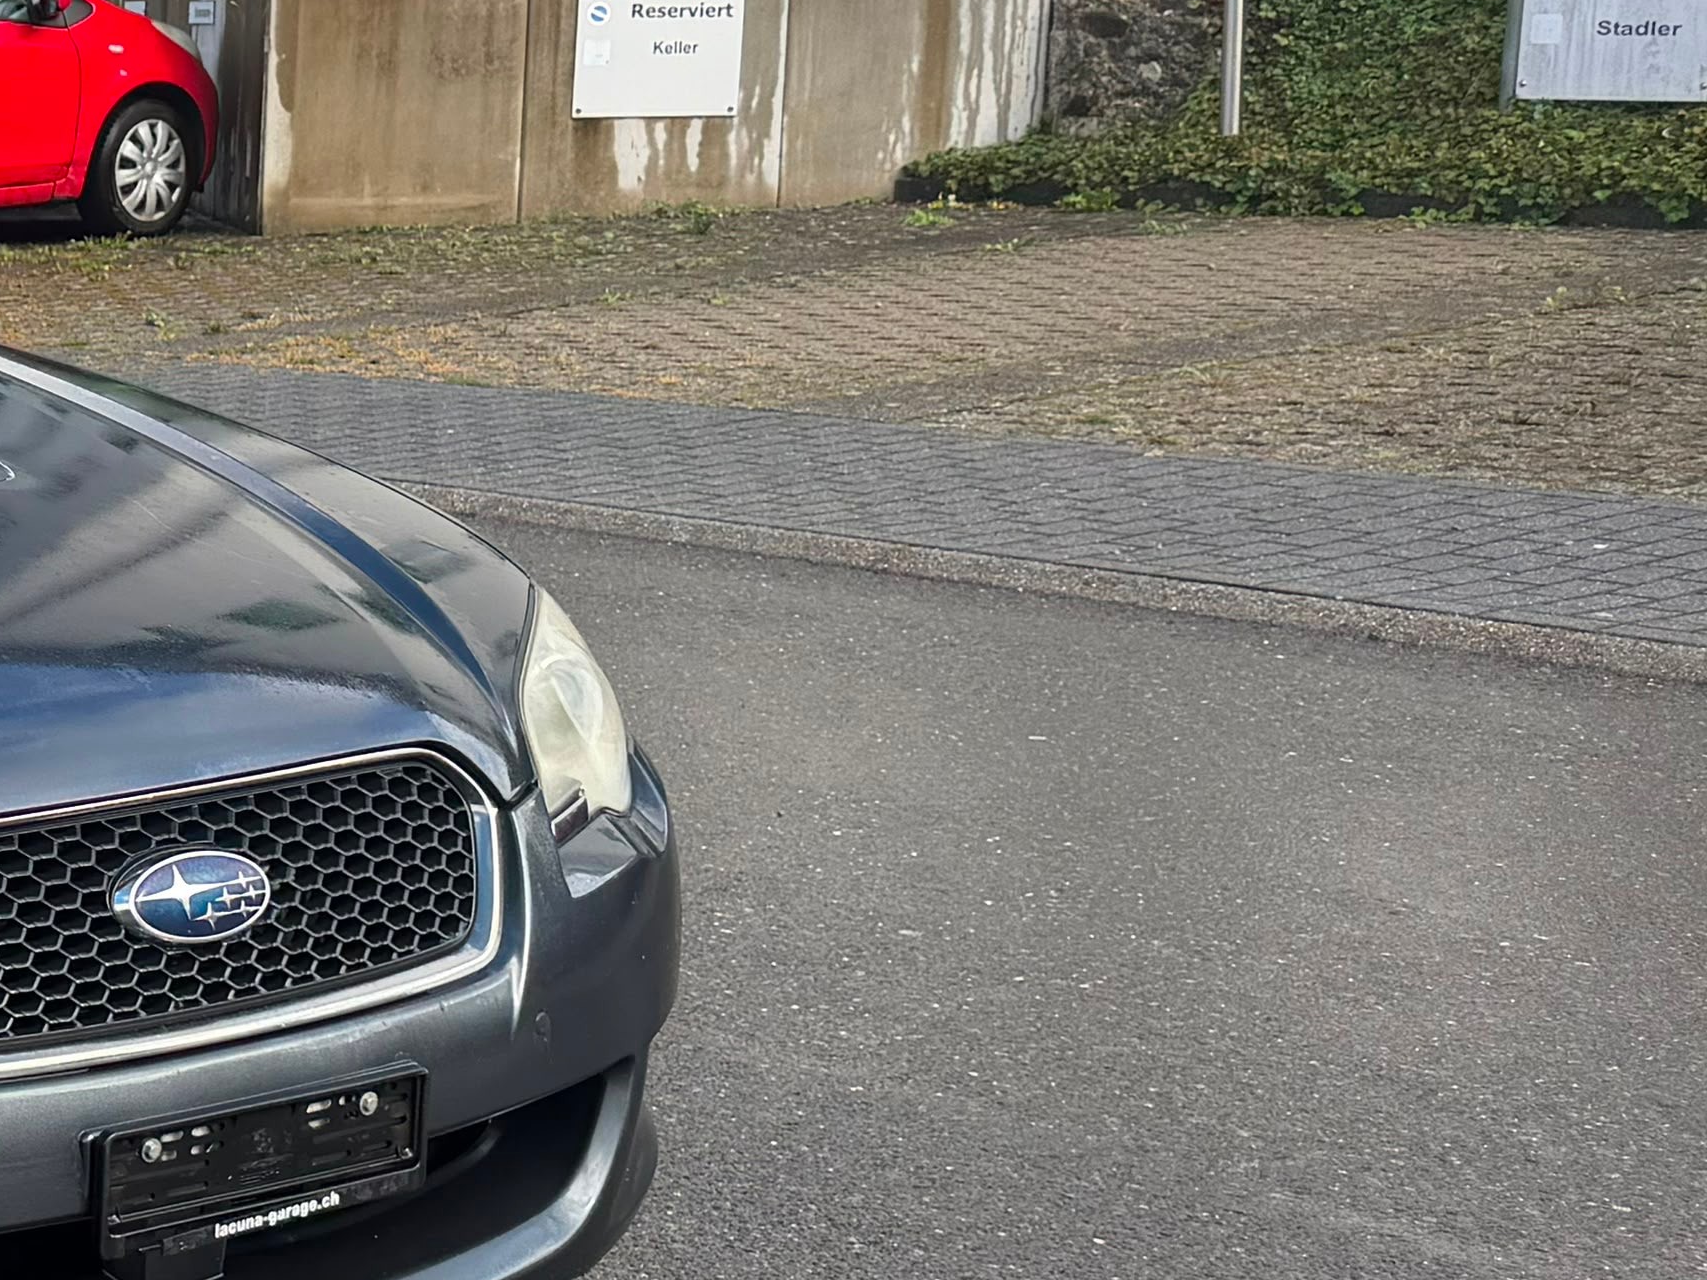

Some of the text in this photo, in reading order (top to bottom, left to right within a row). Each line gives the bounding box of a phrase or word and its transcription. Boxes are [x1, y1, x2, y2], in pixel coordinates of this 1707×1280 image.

[631, 2, 734, 19] Reserviert
[1596, 20, 1683, 37] Stadler
[652, 40, 699, 55] Keller
[214, 1191, 340, 1238] lacuna-garage.ch
